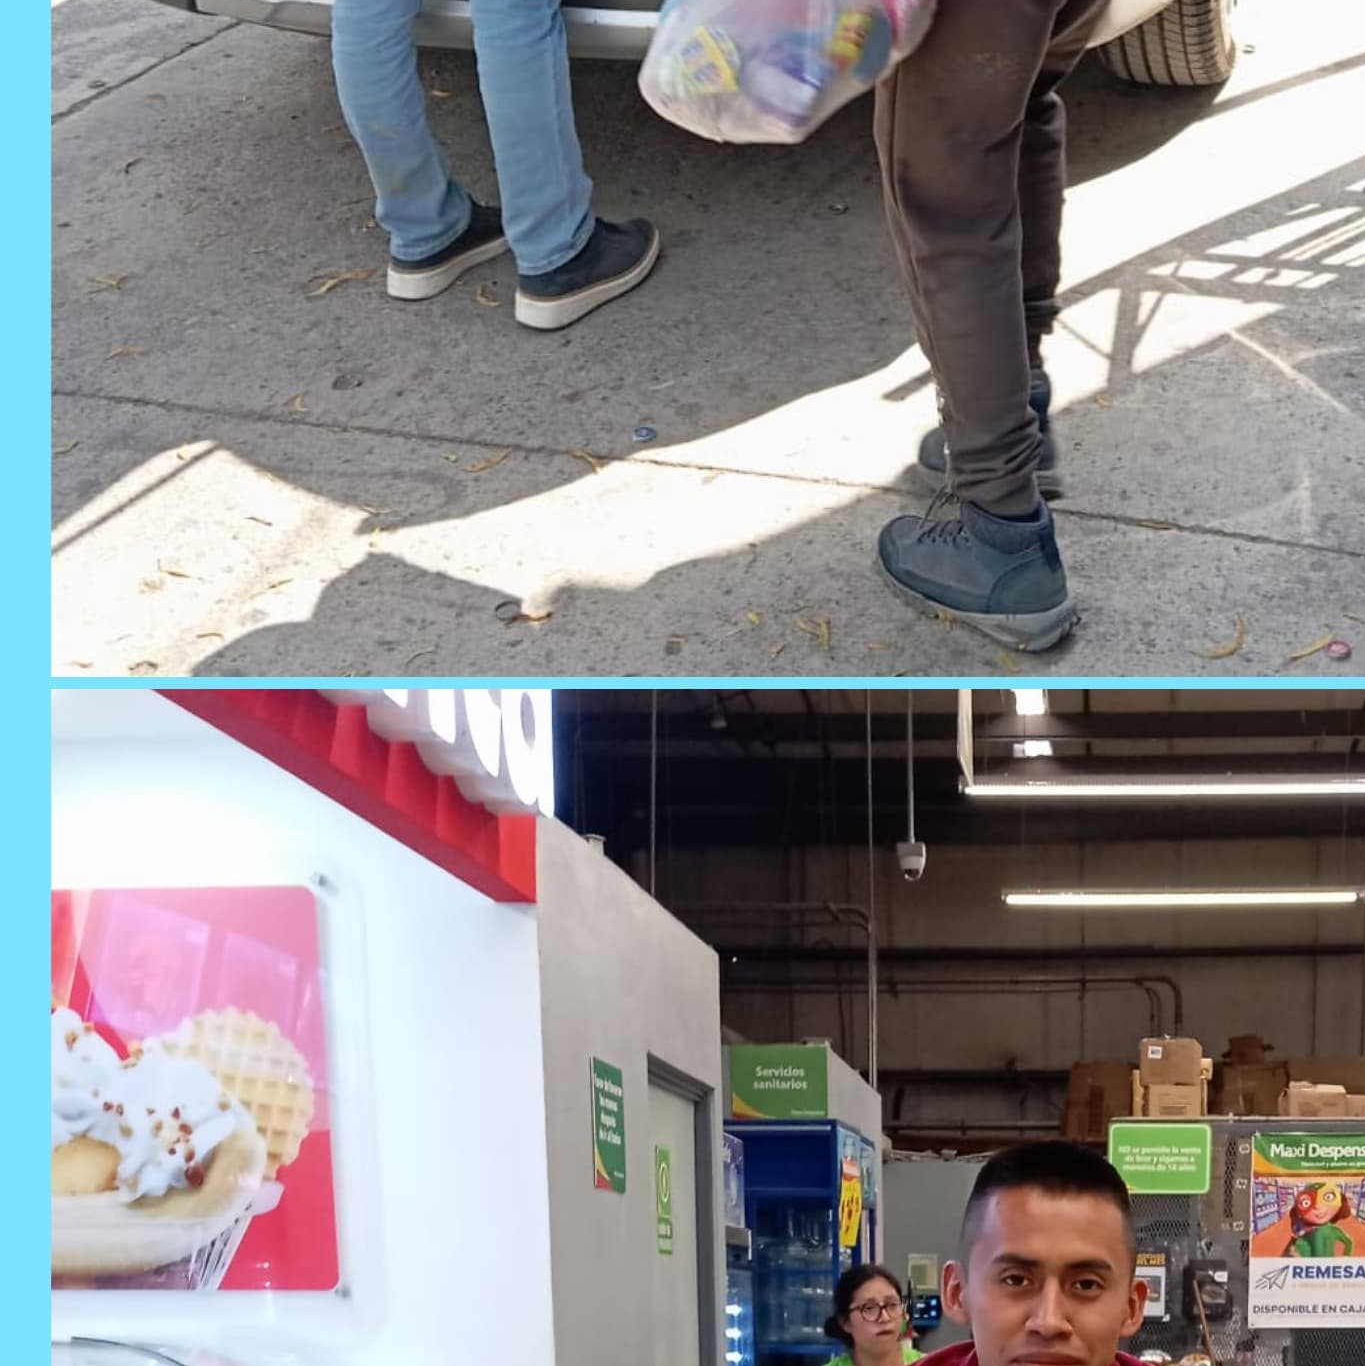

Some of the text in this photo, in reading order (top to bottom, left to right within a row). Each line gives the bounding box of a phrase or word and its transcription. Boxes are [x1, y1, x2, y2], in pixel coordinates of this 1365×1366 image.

[755, 1066, 805, 1078] Servicios
[753, 1079, 808, 1090] sanitarios
[1270, 1143, 1306, 1158] Maxi
[1252, 1304, 1319, 1314] DISPONIBLE
[1322, 1304, 1336, 1314] EN
